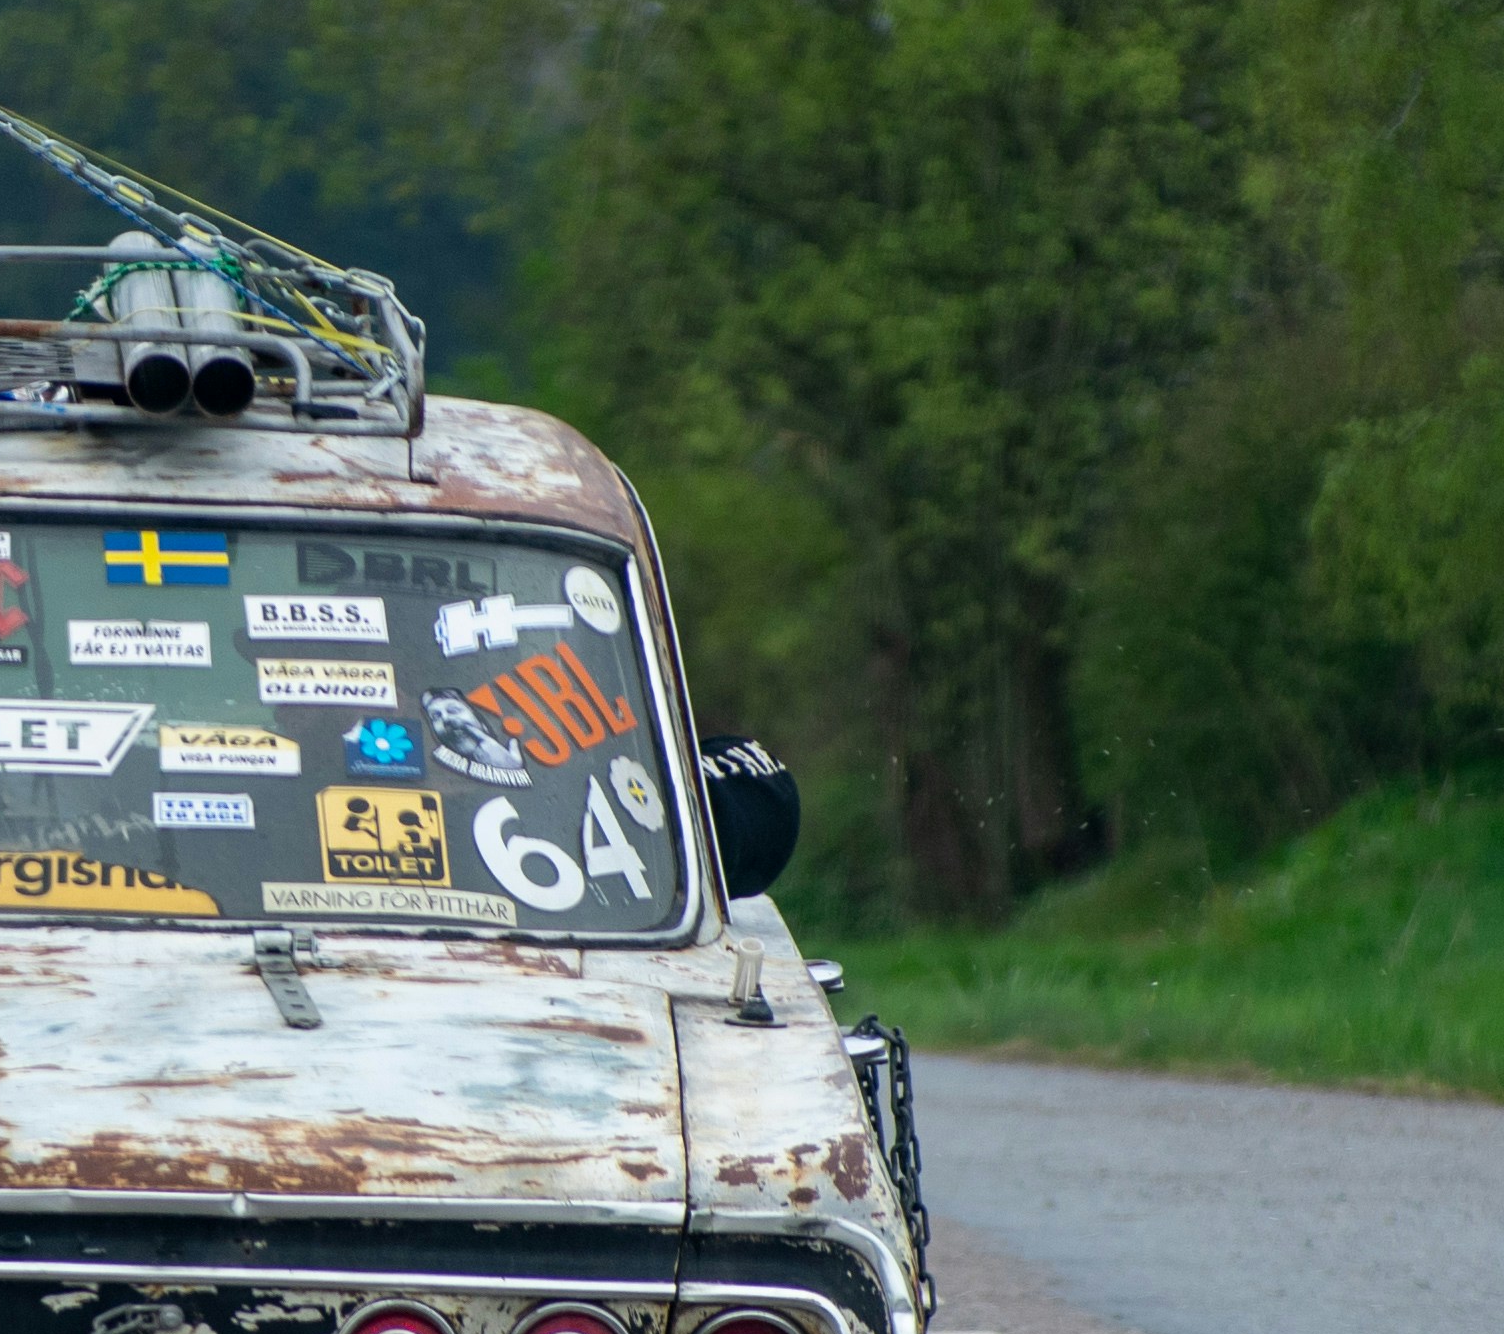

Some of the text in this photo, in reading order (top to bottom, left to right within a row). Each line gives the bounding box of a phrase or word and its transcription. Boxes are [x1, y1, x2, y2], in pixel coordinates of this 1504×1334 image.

[572, 593, 616, 613] CALTEX
[261, 603, 370, 624] B.B.S.S.
[93, 626, 182, 640] FORNMINNE
[74, 641, 205, 658] FÅR EJ TVÄTTAS
[180, 753, 277, 765] VISA PUNGEN
[473, 775, 653, 912] 64
[334, 853, 436, 873] TOILET
[271, 889, 373, 908] VARNING
[380, 888, 422, 910] FÖR
